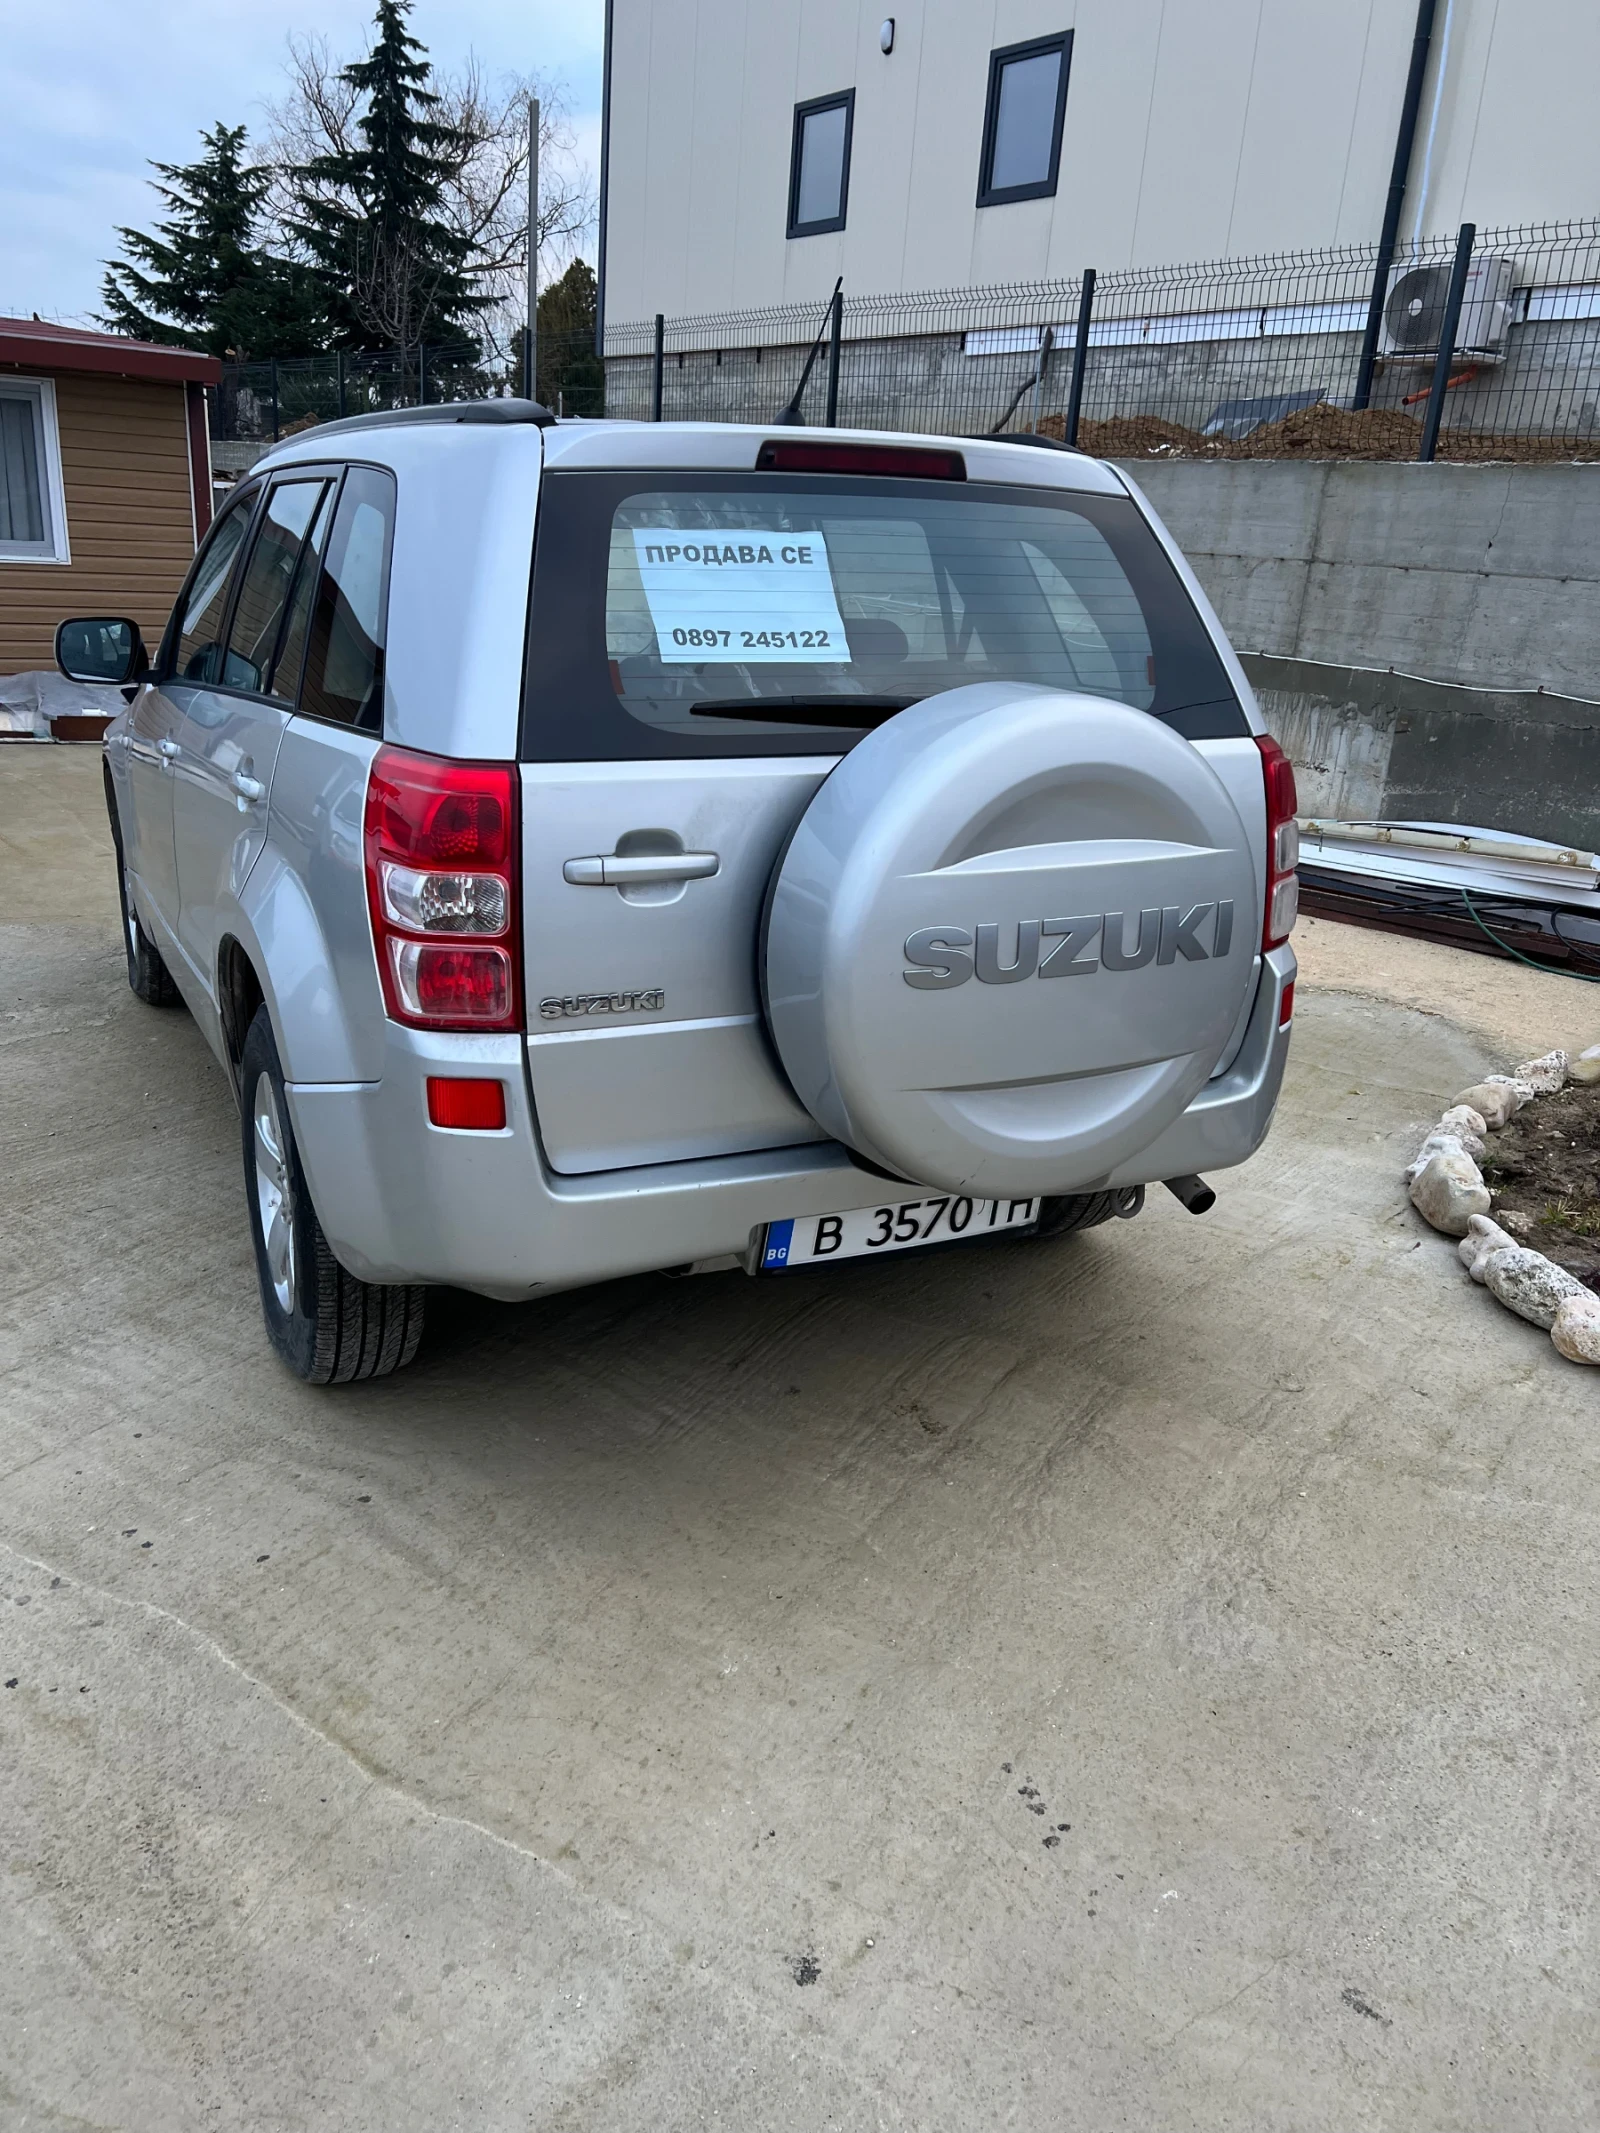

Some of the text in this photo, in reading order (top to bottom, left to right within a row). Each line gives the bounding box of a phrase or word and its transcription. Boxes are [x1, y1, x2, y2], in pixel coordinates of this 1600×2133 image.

[645, 544, 813, 566] ПРОДАВА СЕ
[672, 628, 830, 648] 0897 245122
[903, 899, 1234, 990] SUZUKI
[540, 989, 664, 1019] SUZUKI
[812, 1216, 844, 1256] B
[866, 1197, 974, 1247] 3570
[766, 1247, 787, 1261] BG
